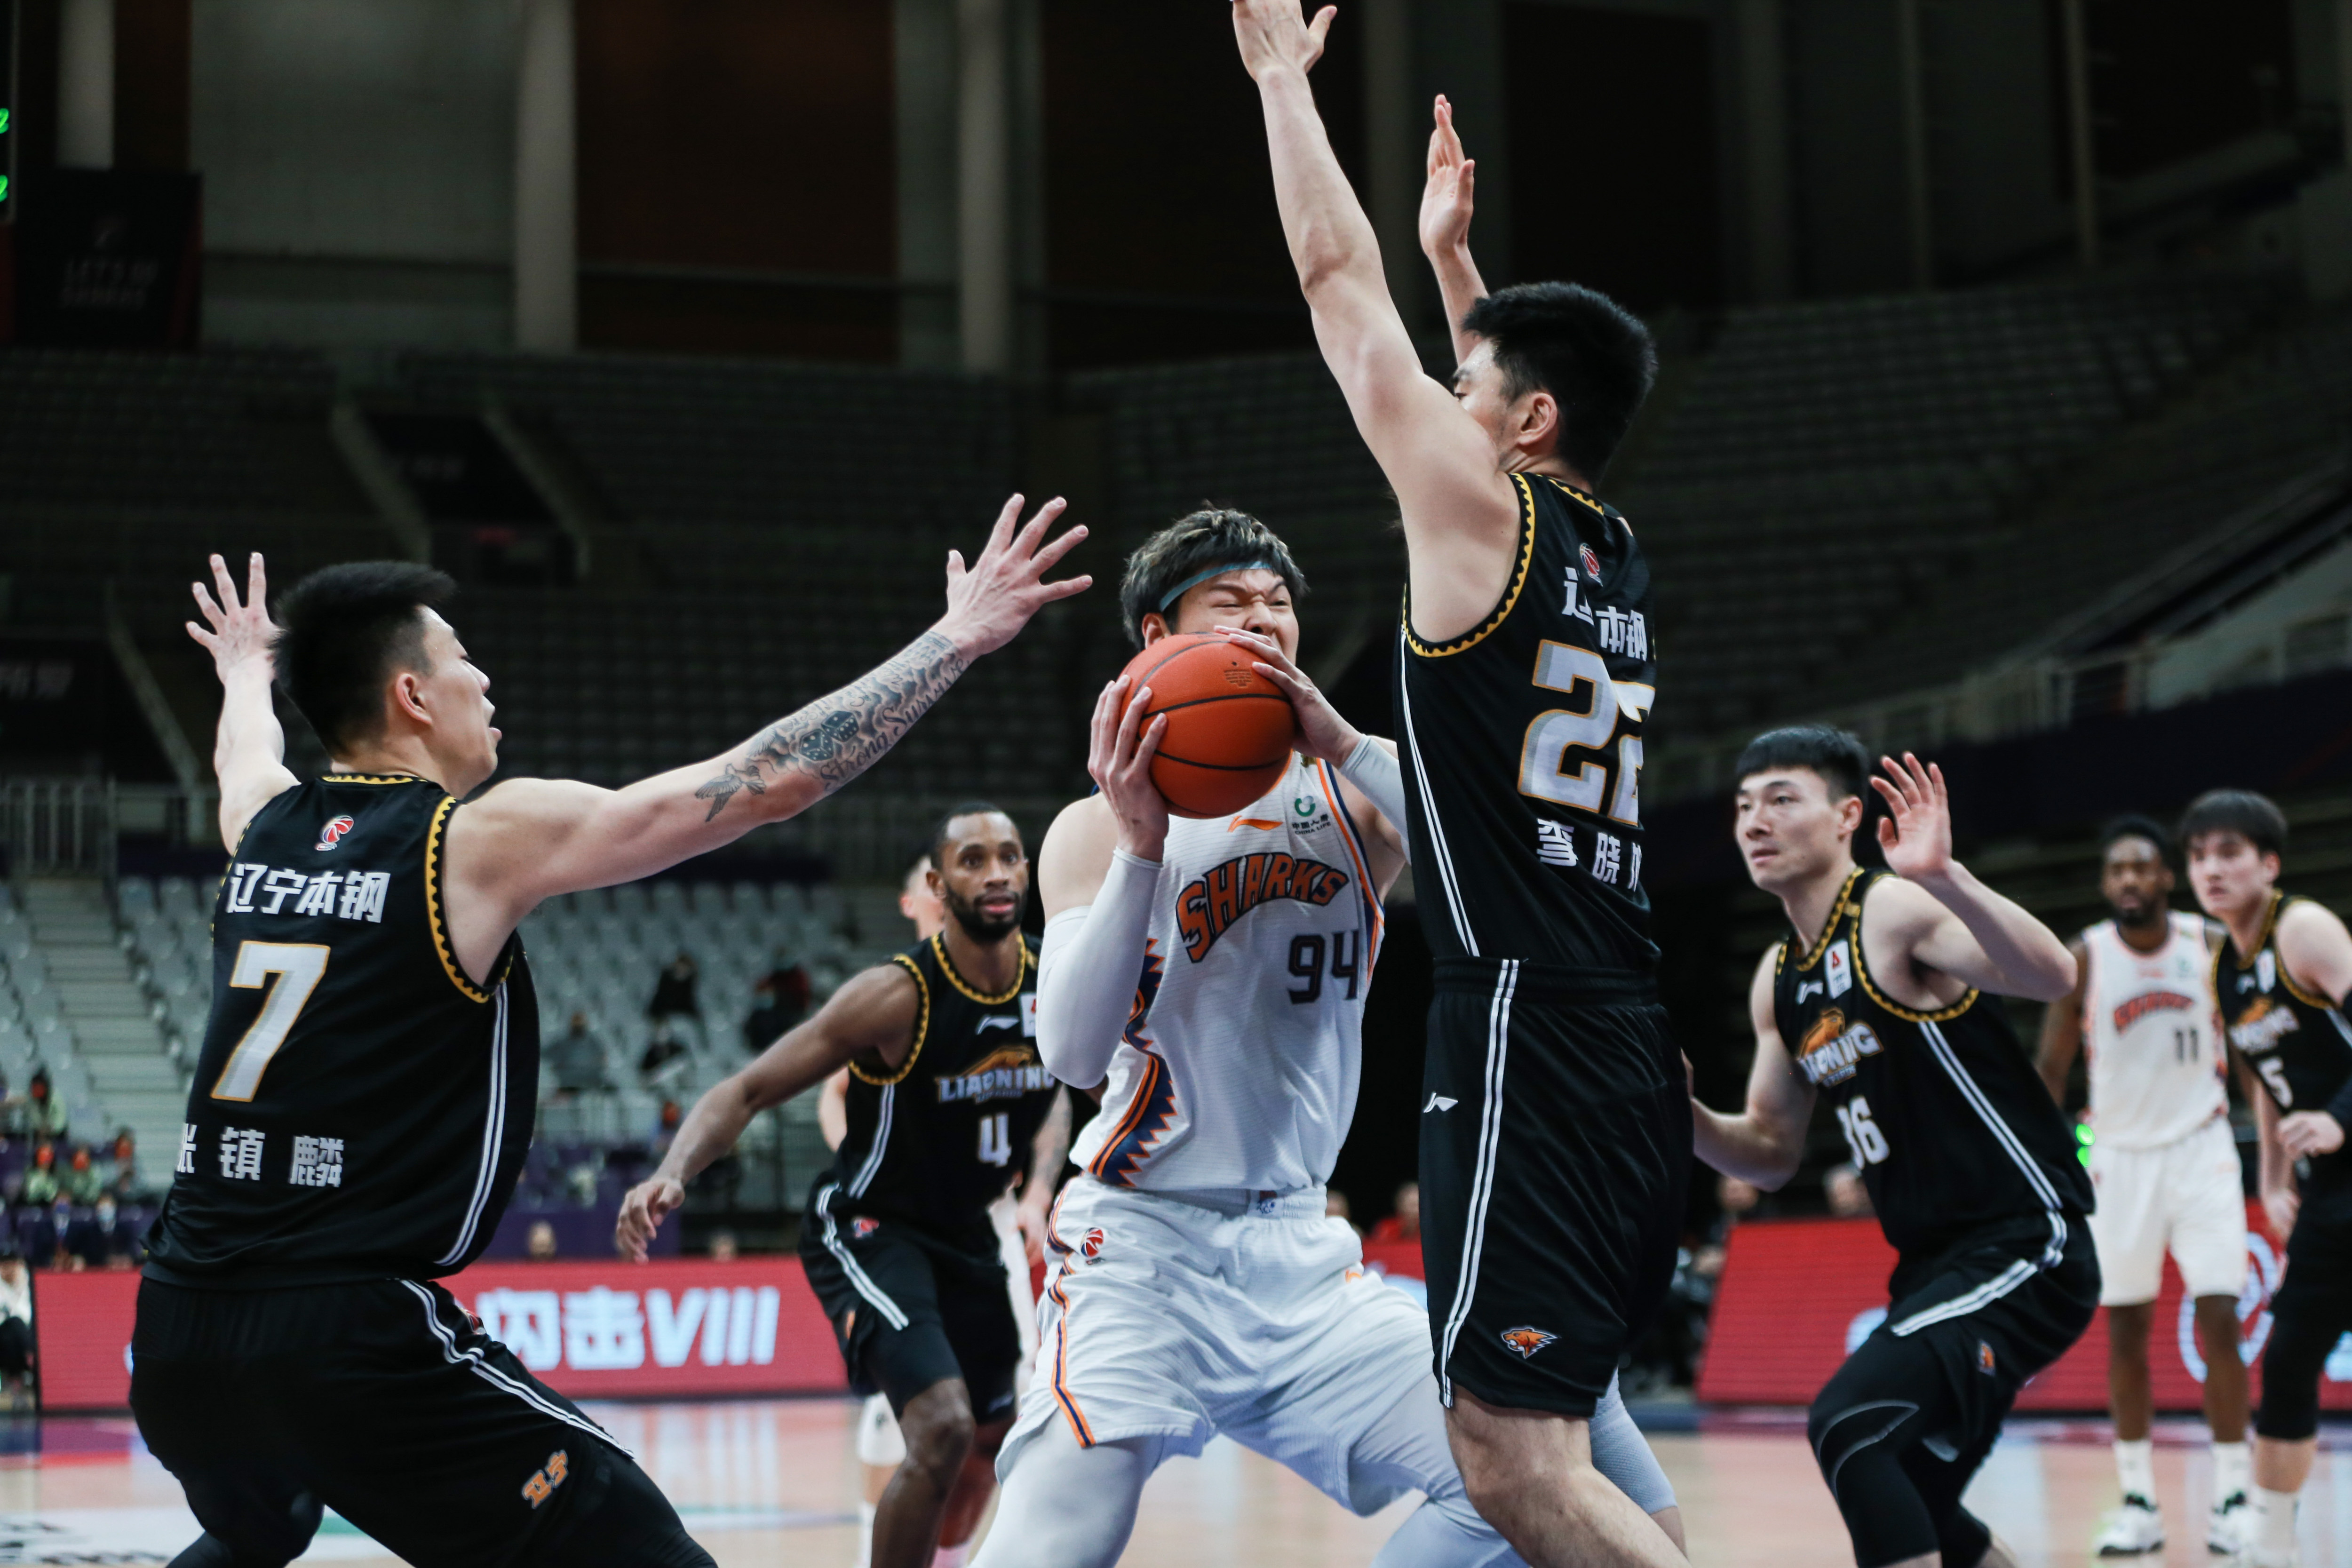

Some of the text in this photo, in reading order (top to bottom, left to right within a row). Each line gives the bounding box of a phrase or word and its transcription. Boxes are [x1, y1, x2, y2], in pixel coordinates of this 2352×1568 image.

[820, 731, 892, 790] Strong
[225, 863, 391, 923] 辽宁本钢
[1176, 852, 1350, 963] SHARKS
[1287, 930, 1359, 1005] 94
[210, 940, 331, 1102] 7
[978, 1112, 1012, 1168] 4
